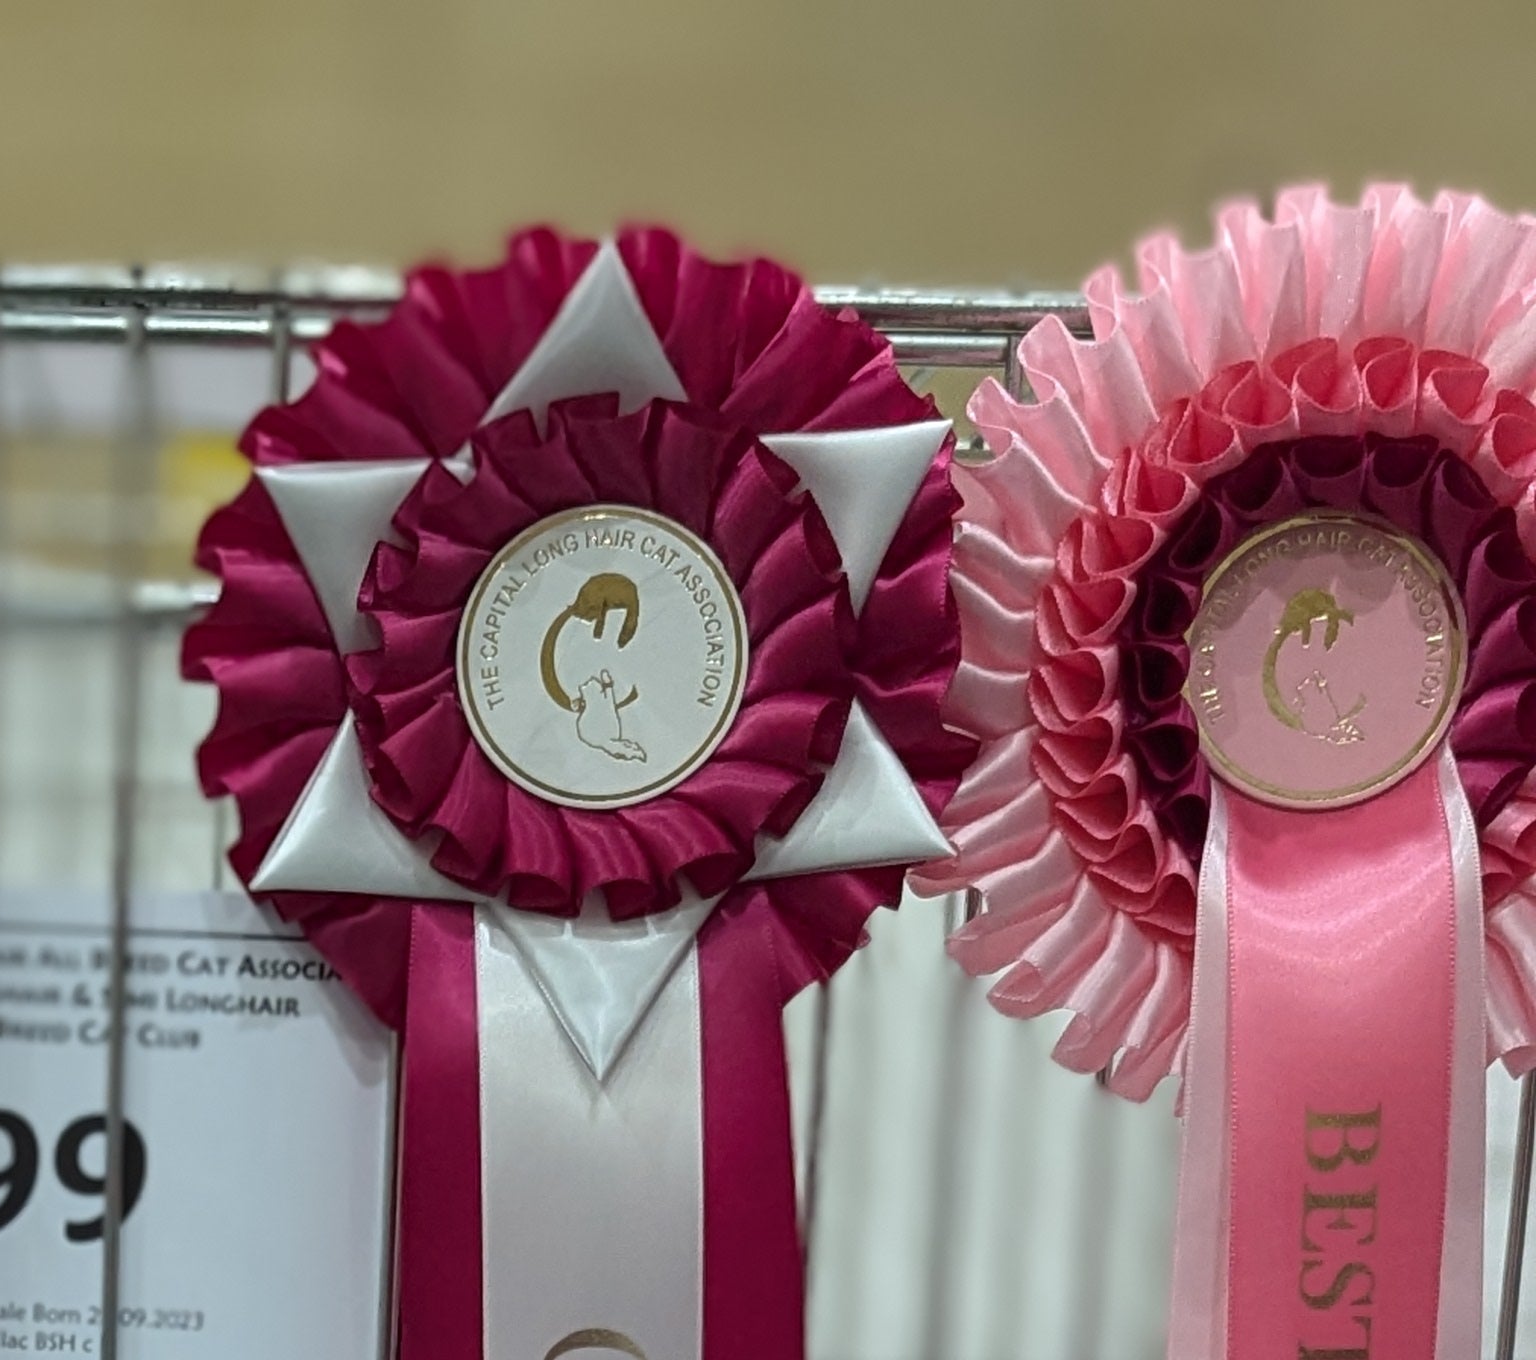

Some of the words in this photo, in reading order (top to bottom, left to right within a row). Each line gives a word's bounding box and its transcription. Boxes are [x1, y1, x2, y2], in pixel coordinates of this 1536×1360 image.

[521, 532, 579, 577] LONG
[585, 528, 636, 550] HAIR
[640, 536, 681, 570] CAT
[479, 575, 527, 662] CAPITAL
[674, 564, 726, 708] ASSOCIATION
[480, 665, 505, 711] THE
[177, 951, 230, 977] CAT
[238, 955, 344, 982] ASSOCIA
[32, 1303, 82, 1325] Born
[35, 1331, 76, 1351] BSH
